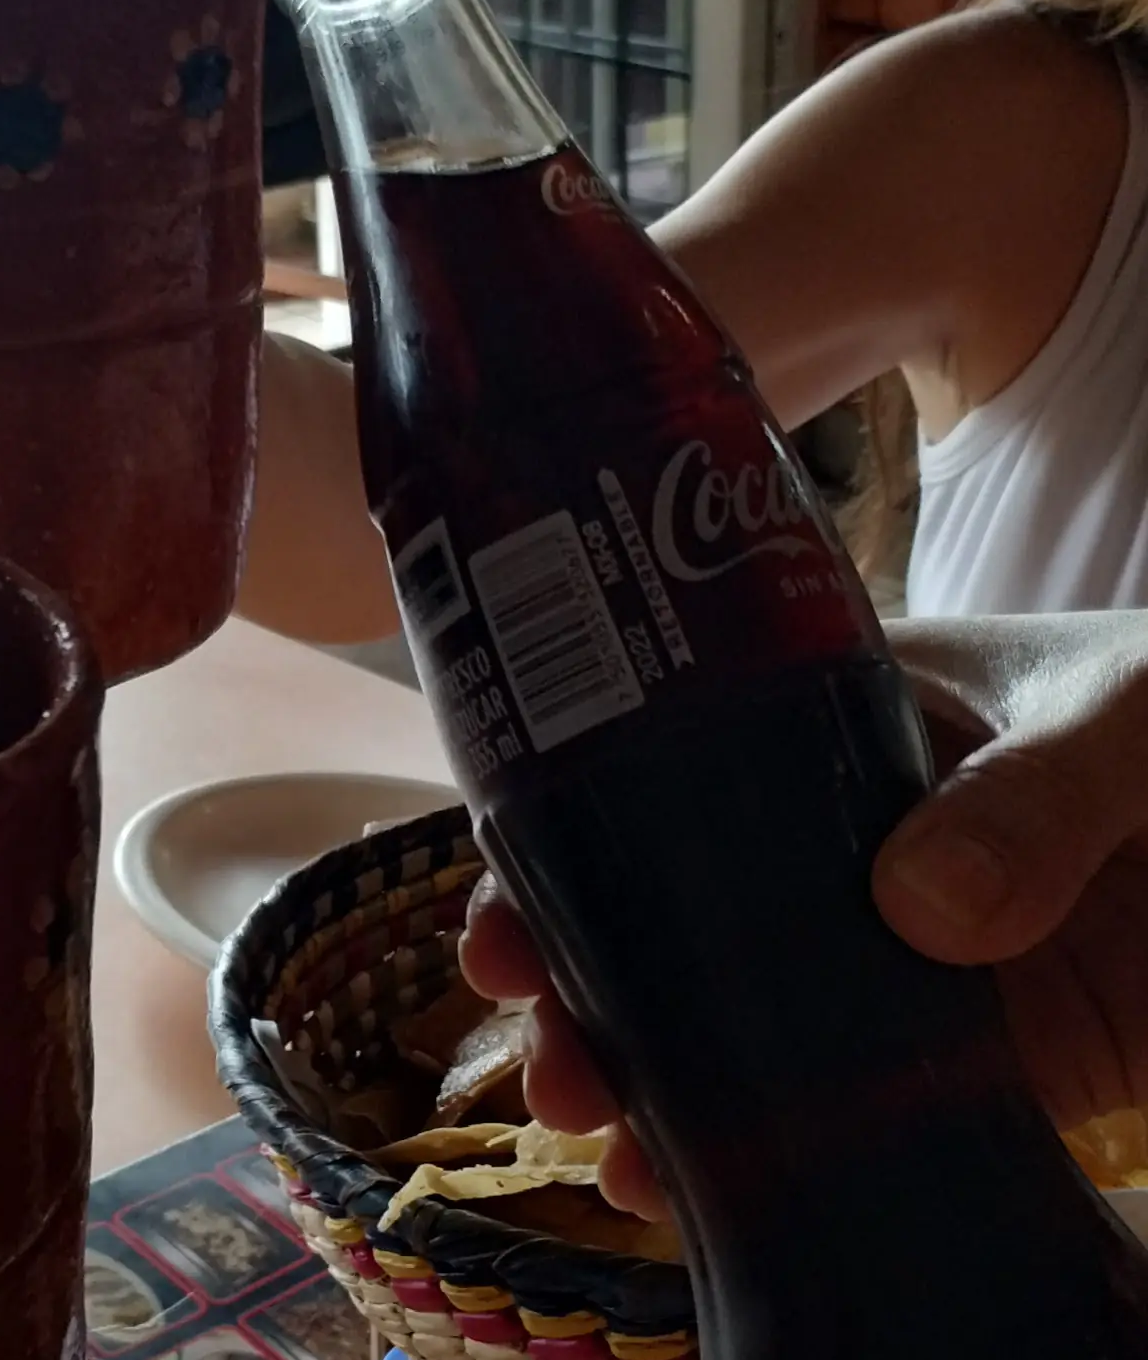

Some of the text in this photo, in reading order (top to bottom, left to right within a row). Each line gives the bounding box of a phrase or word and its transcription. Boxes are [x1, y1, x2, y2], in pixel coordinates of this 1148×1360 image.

[540, 163, 610, 217] Coca
[651, 439, 818, 583] Coca
[609, 490, 683, 653] RETORNABLE
[779, 571, 824, 600] SIN
[624, 620, 665, 686] 2022
[495, 721, 525, 762] ml
